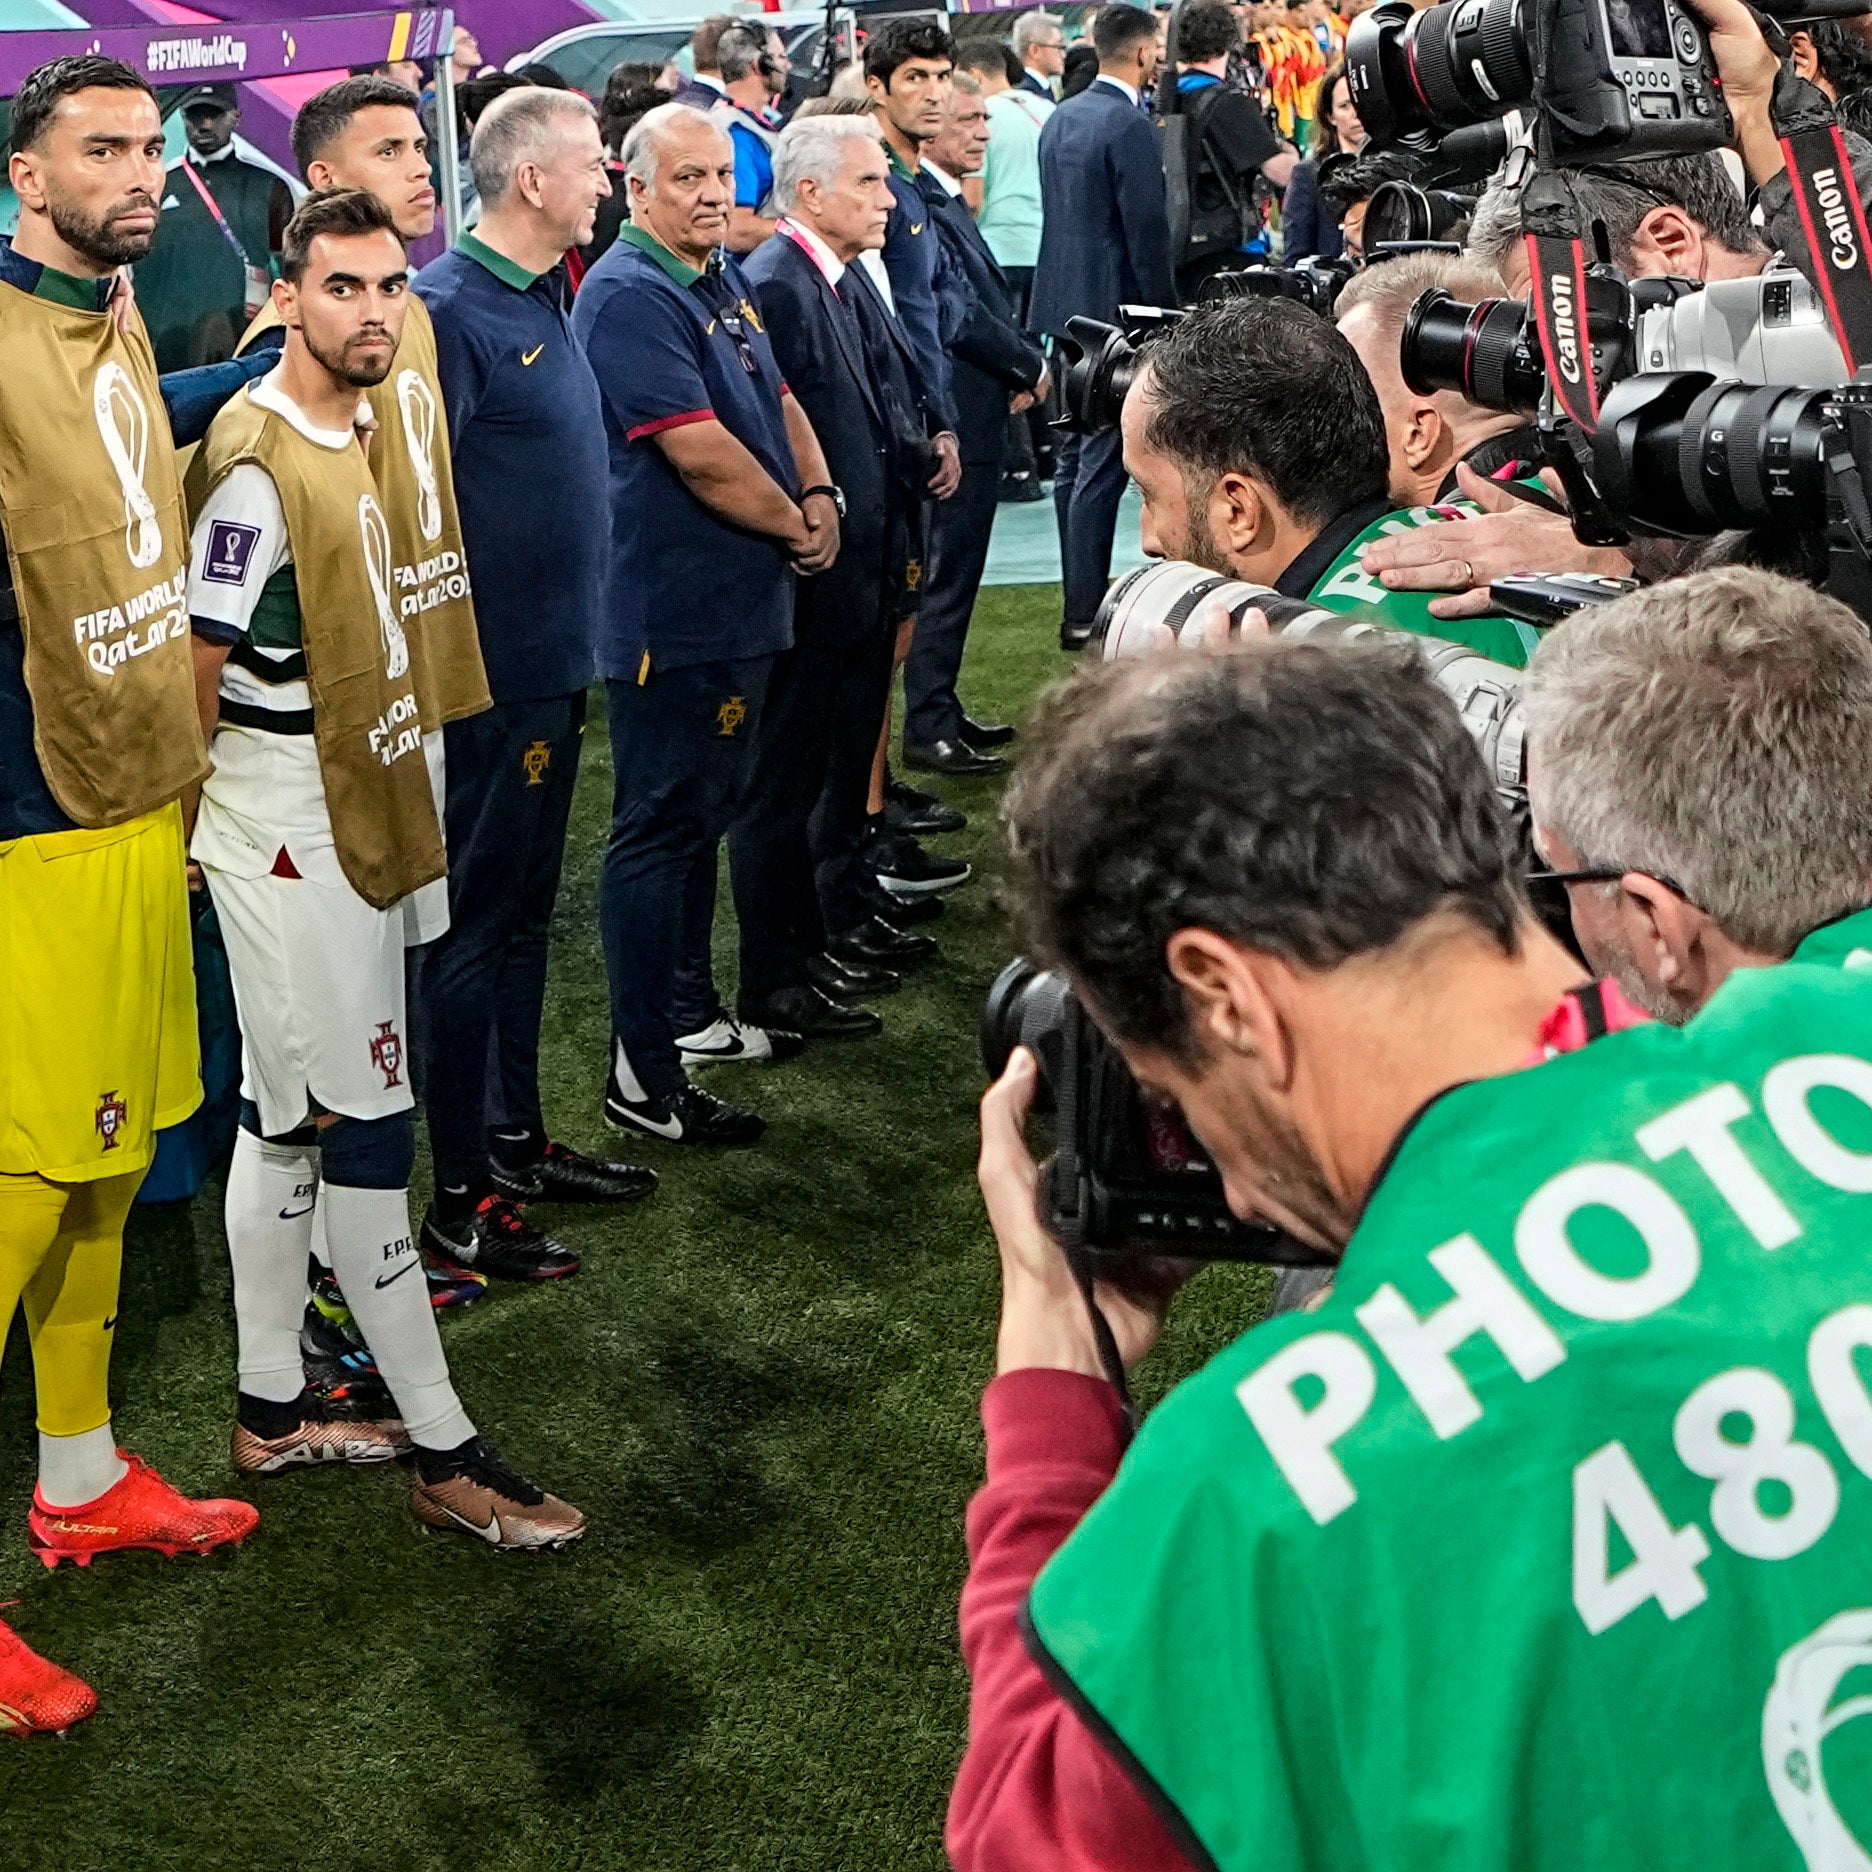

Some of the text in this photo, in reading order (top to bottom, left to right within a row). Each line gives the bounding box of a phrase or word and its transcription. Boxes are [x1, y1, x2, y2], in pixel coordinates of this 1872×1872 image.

[147, 35, 247, 71] #FIFAWorldCup
[1812, 168, 1857, 270] Canon
[1551, 275, 1579, 384] Canon
[74, 575, 184, 644] FIFA WORL
